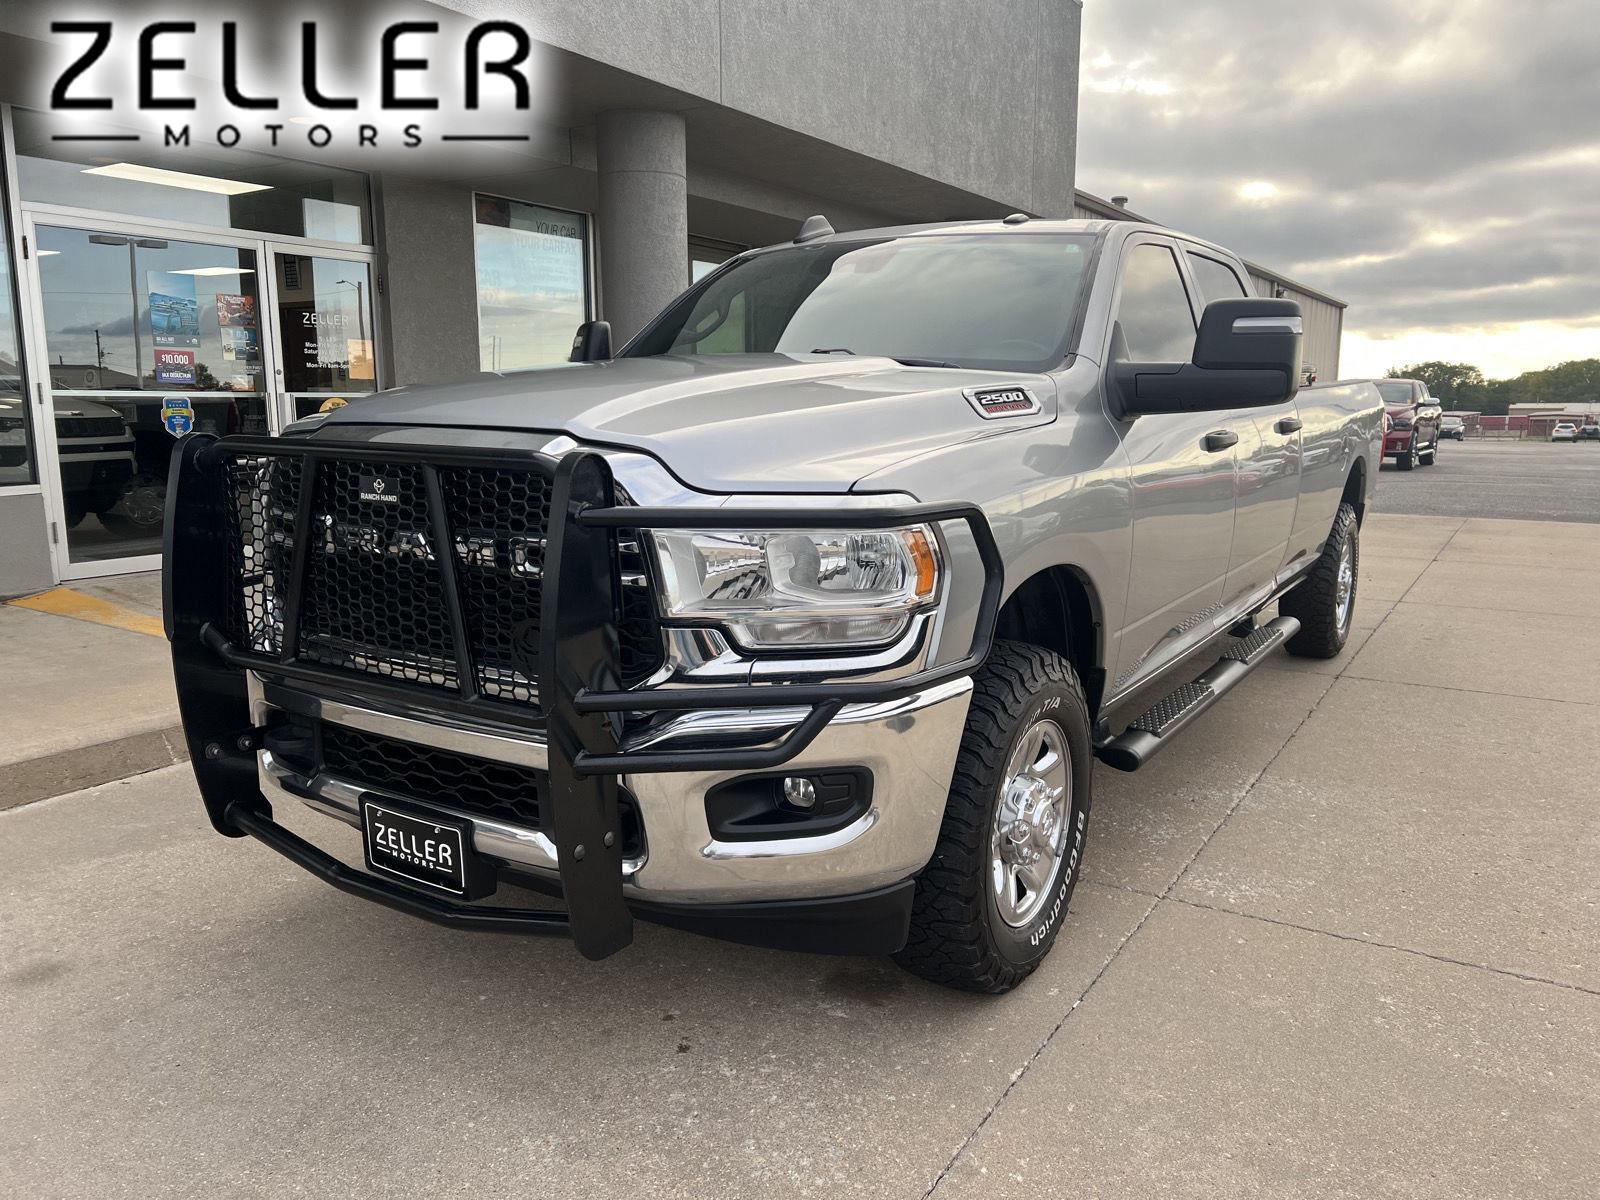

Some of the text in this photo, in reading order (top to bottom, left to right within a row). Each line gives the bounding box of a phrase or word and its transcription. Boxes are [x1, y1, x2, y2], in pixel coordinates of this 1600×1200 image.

[302, 312, 349, 326] ZELLER
[979, 391, 1024, 404] 2500
[360, 492, 398, 502] RANCH HAND
[1042, 696, 1061, 713] T/A
[374, 822, 453, 866] ZELLER
[391, 849, 434, 869] MOTORS
